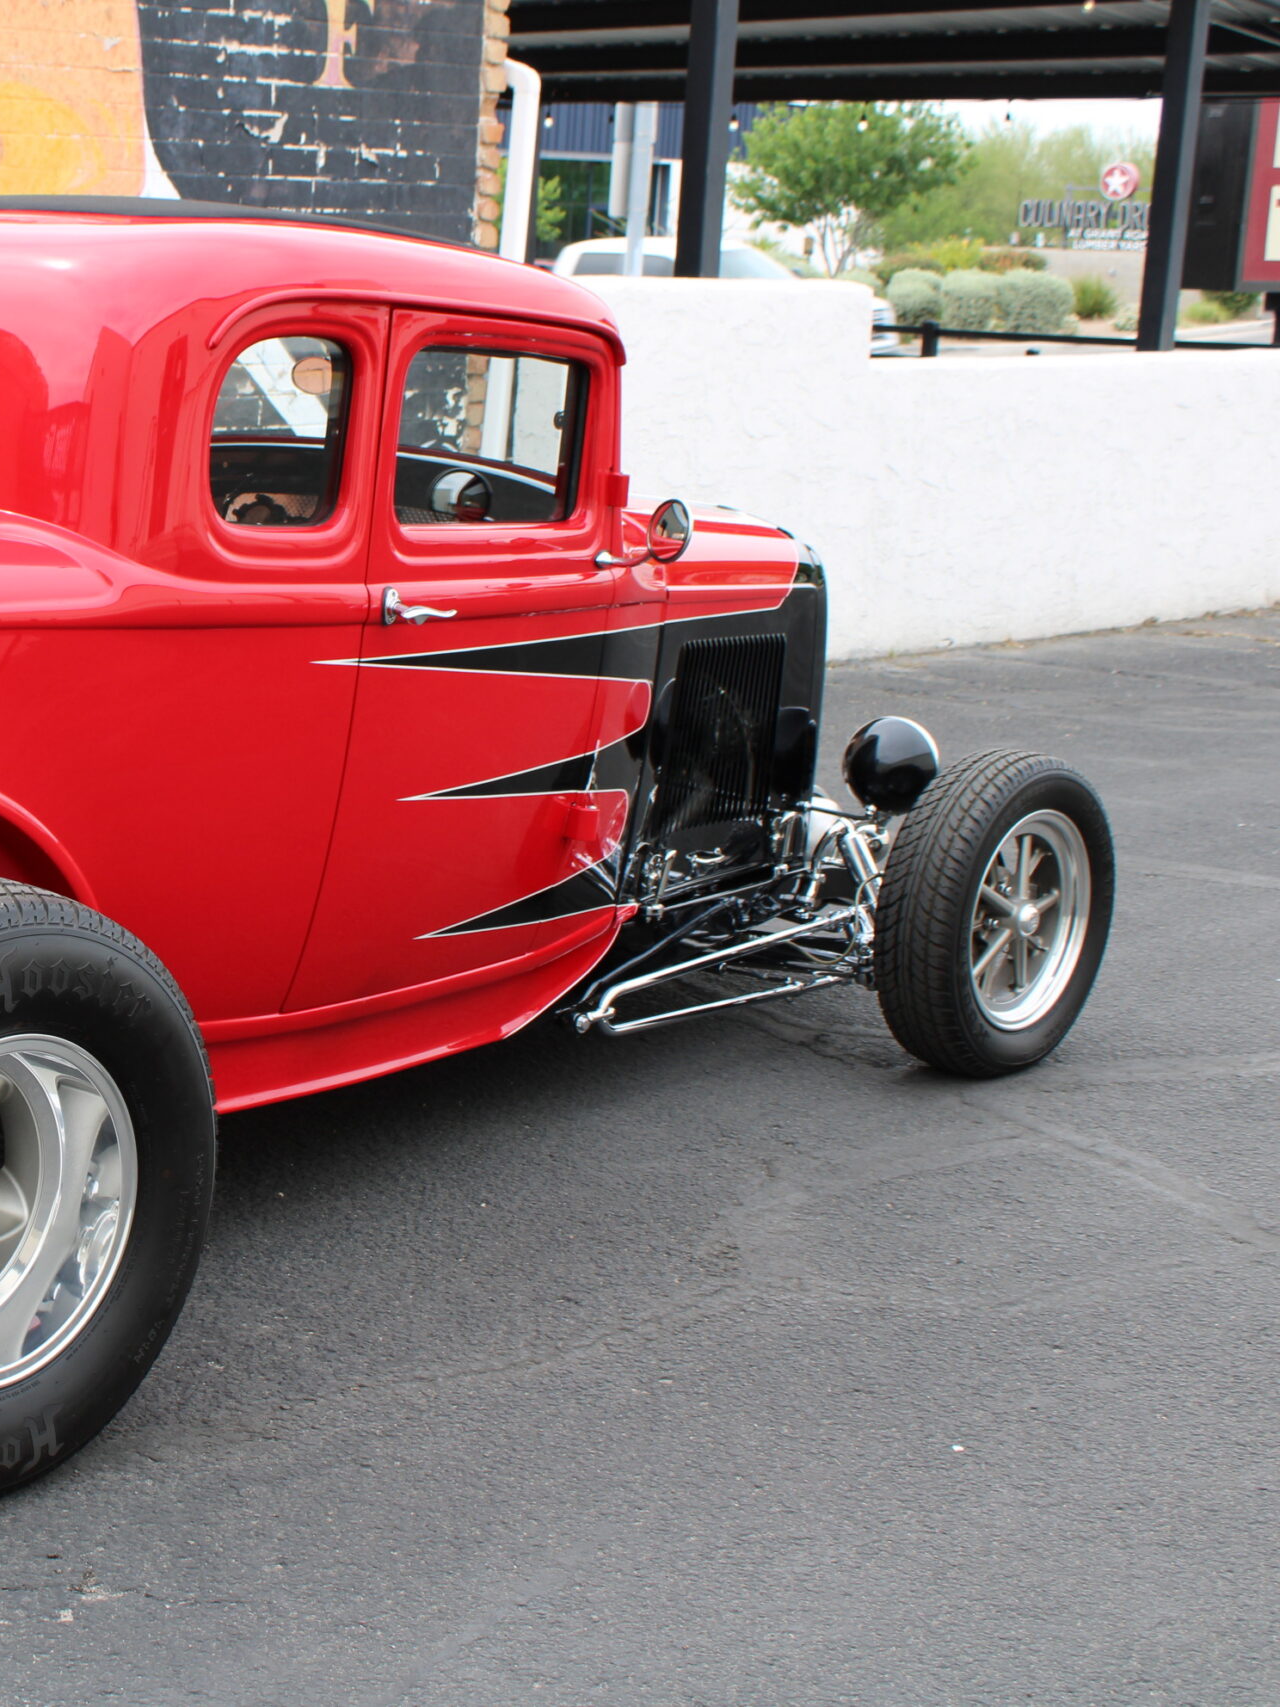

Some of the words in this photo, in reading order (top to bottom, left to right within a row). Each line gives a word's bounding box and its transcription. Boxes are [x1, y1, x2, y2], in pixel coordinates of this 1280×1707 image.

[1019, 199, 1111, 228] CULINARY
[1067, 228, 1082, 238] AT
[1072, 239, 1118, 250] LUMBER
